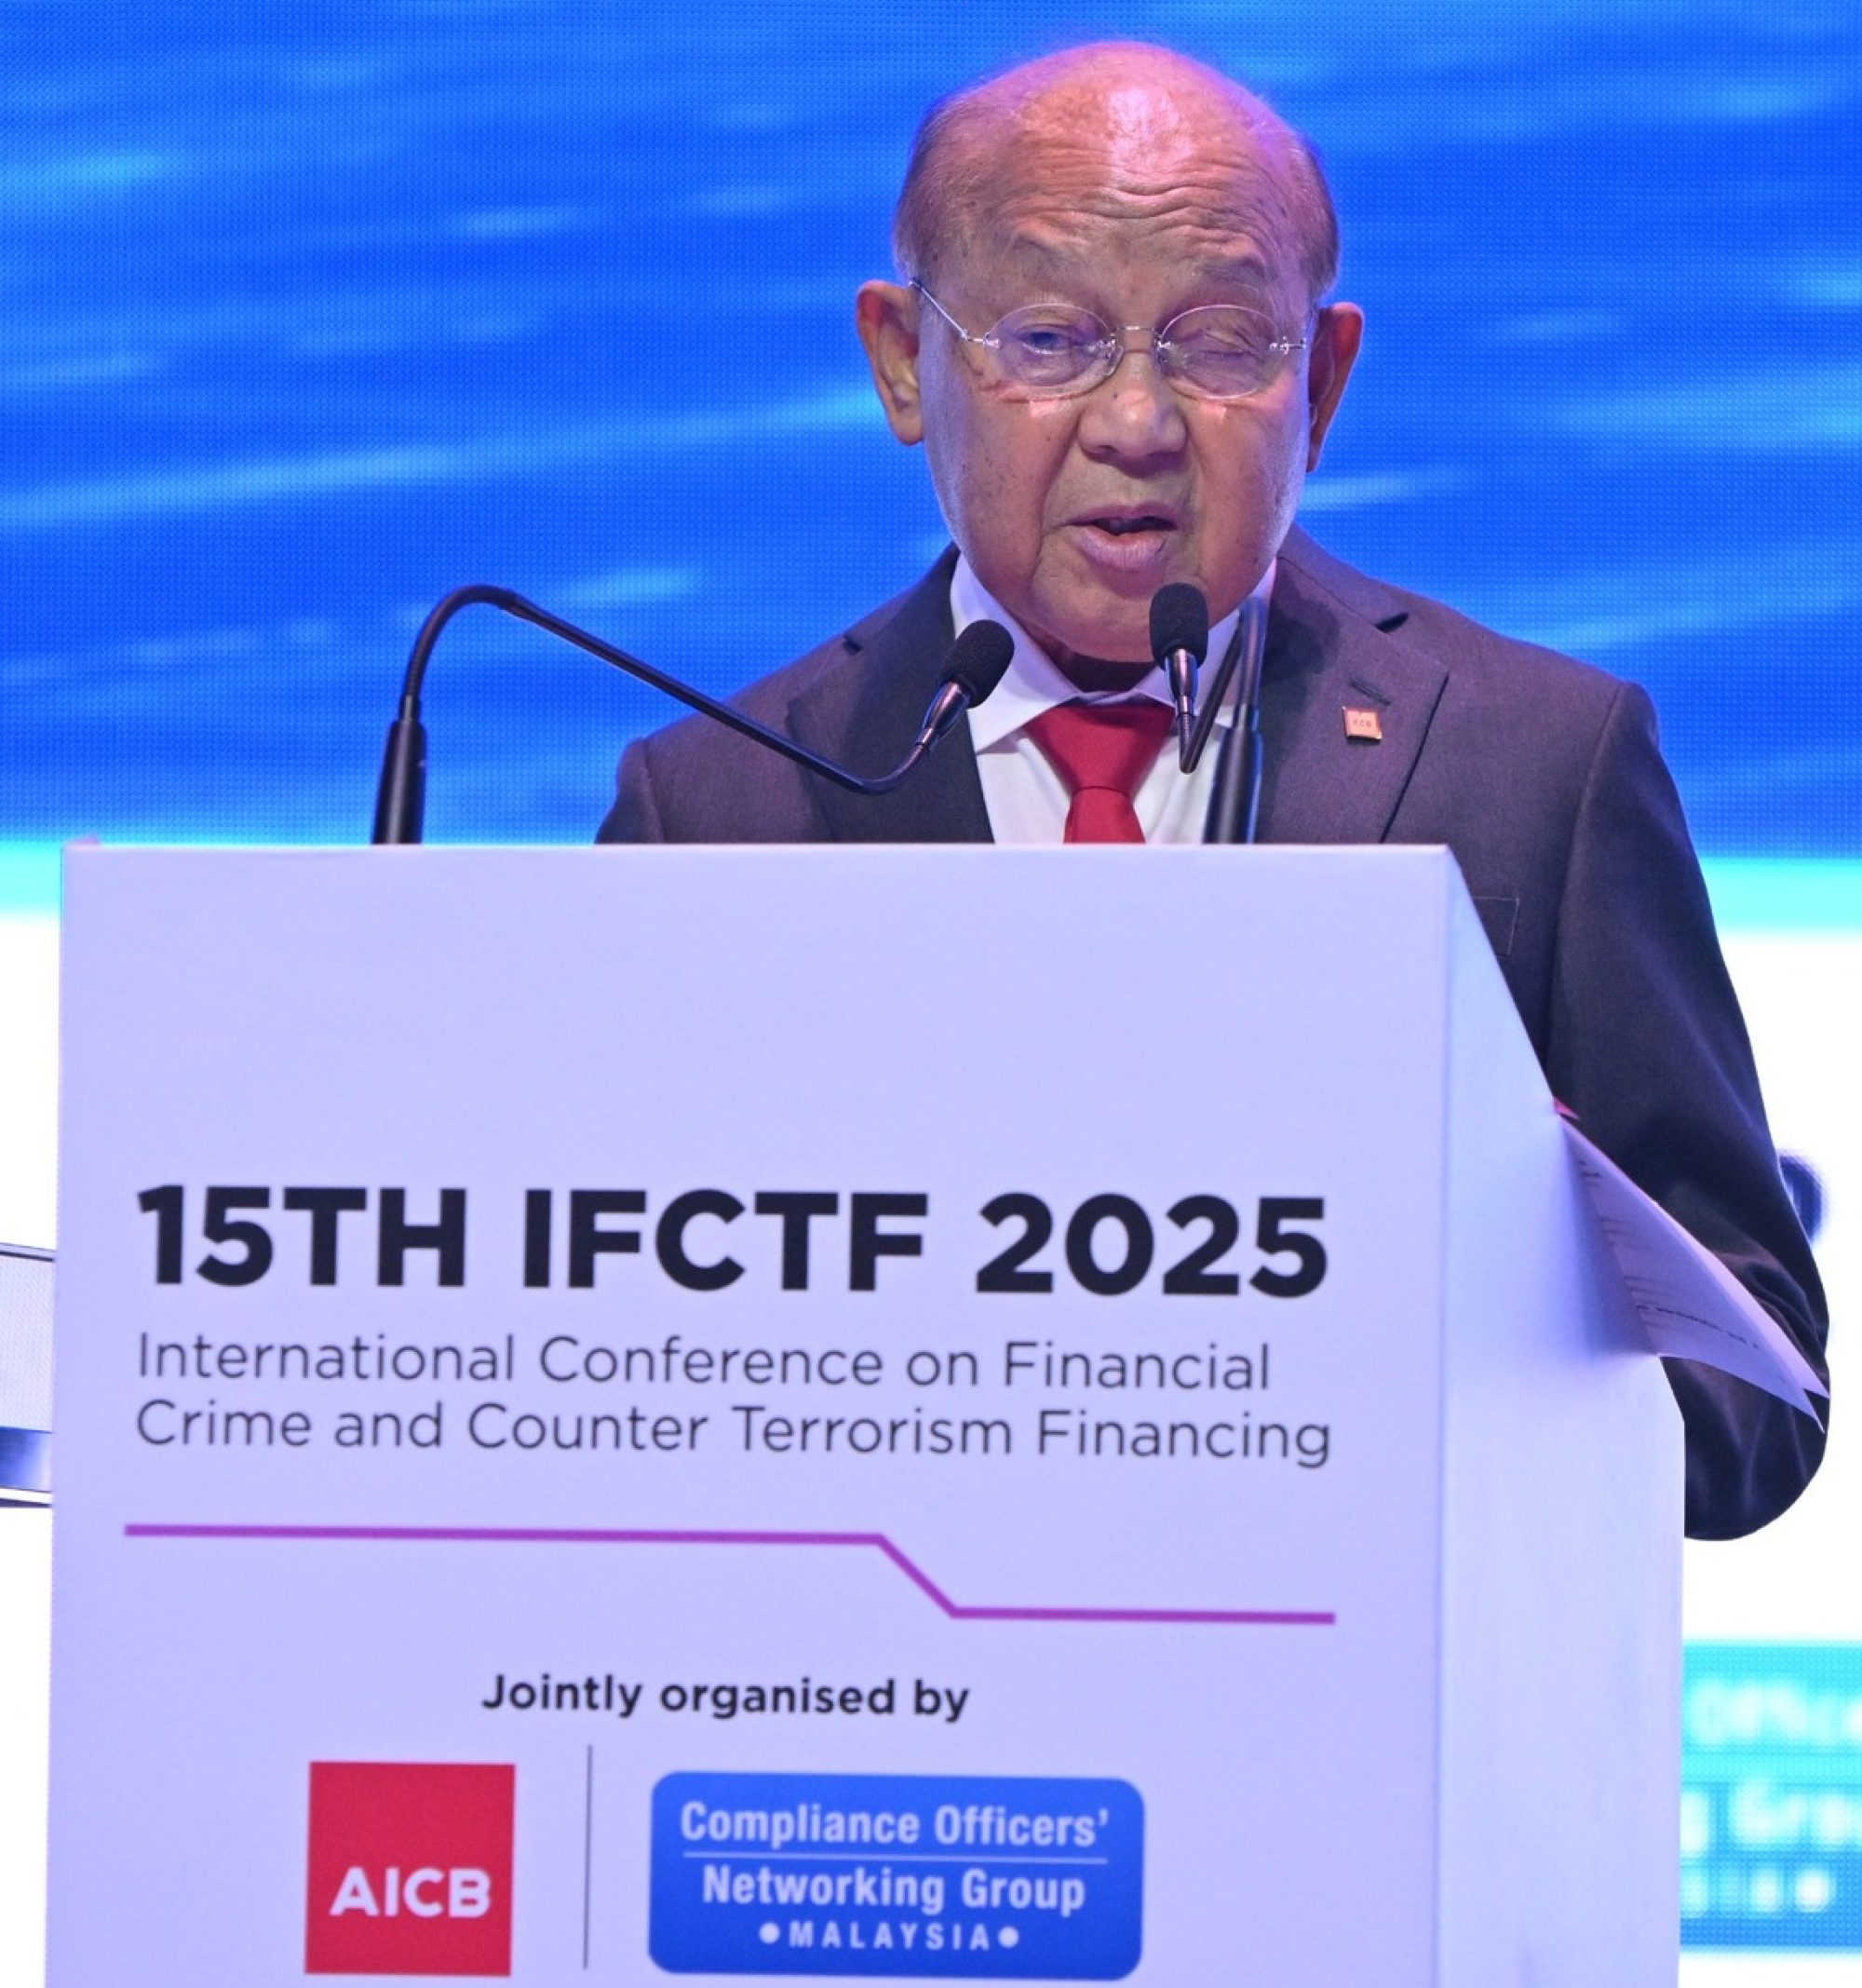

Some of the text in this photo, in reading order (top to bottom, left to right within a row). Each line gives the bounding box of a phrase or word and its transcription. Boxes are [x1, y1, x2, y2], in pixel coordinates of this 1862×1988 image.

[138, 1185, 1328, 1299] 15TH IFCTF 2025
[139, 1332, 1269, 1391] International Conference on Financial
[136, 1399, 1330, 1469] Crime and Counter Terrorism Financing
[481, 1673, 970, 1722] Jointly organised by
[681, 1801, 1109, 1848] Compliance Officers’
[330, 1866, 492, 1918] AICB
[702, 1865, 1088, 1916] Networking Group
[789, 1921, 990, 1950] MALAYSIA
